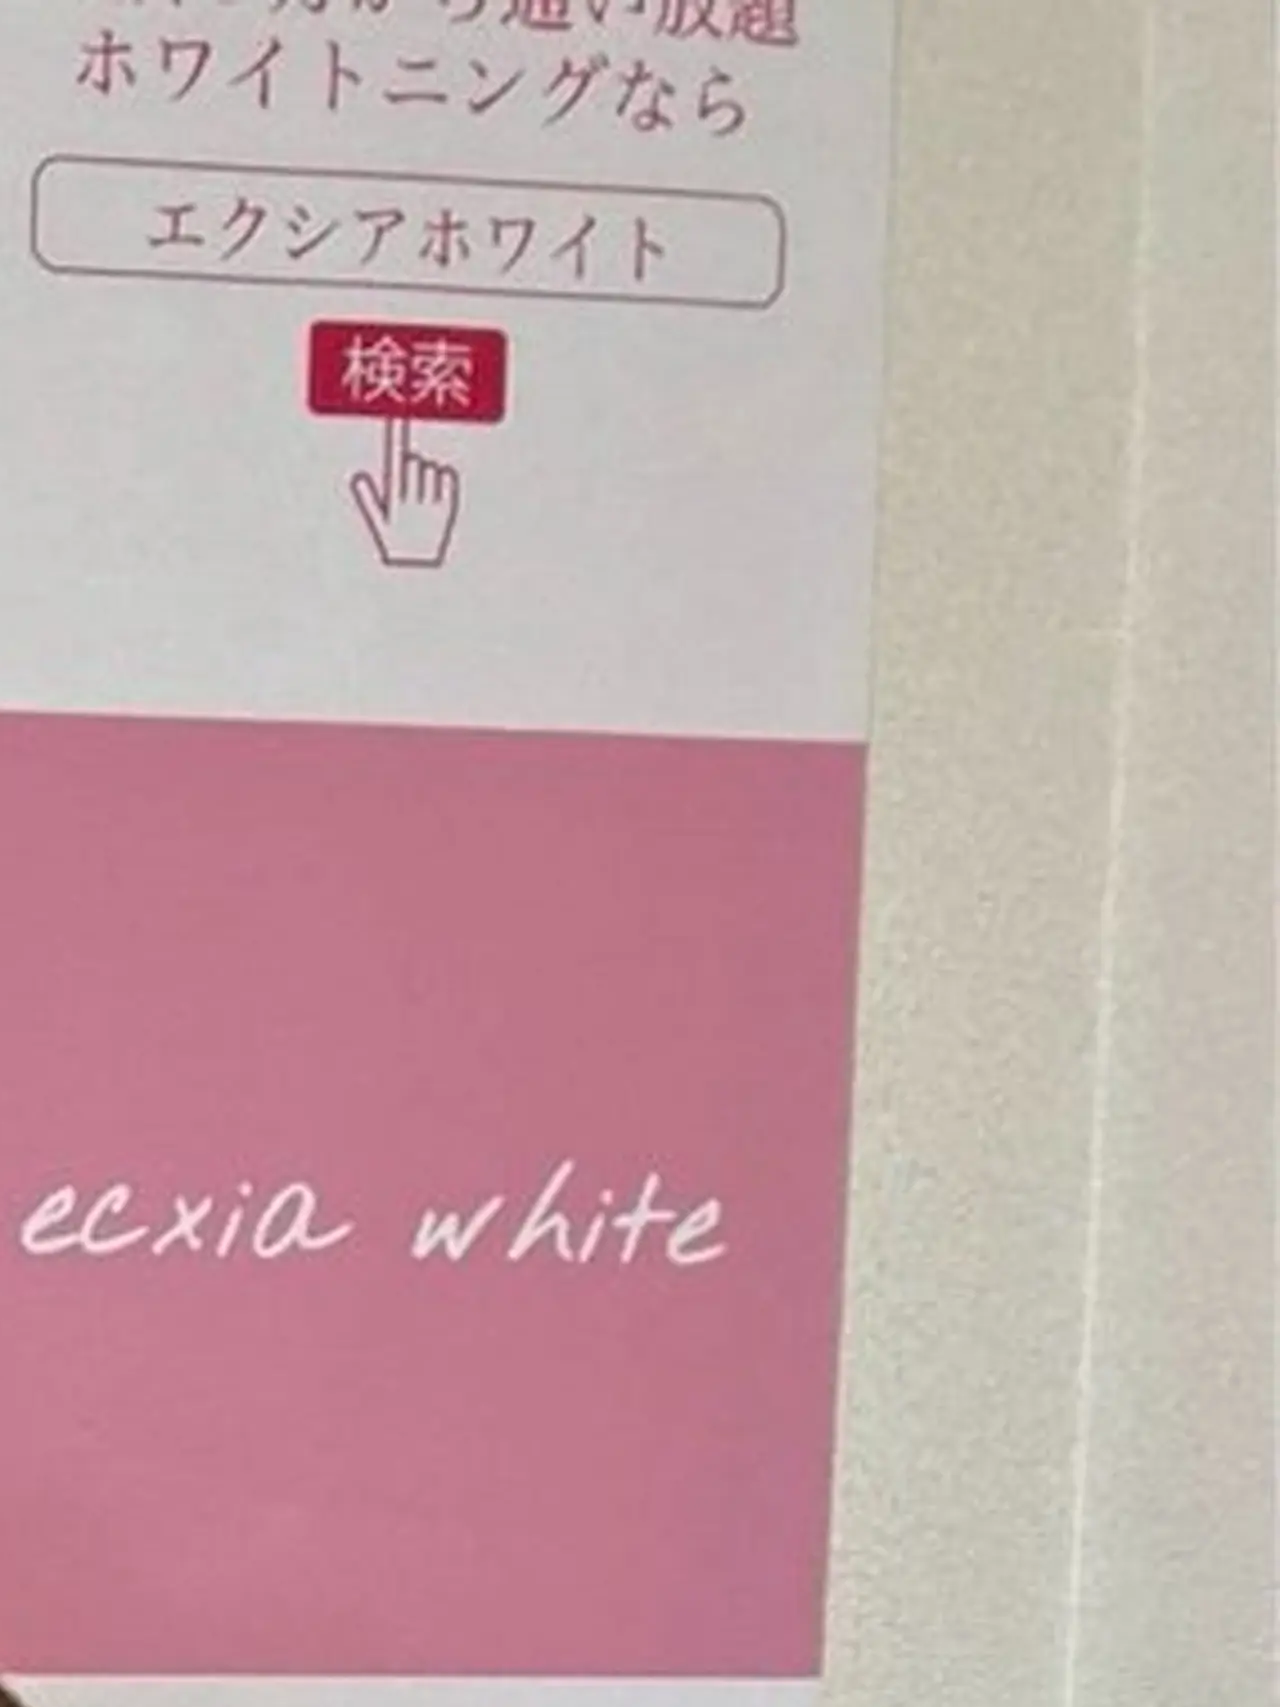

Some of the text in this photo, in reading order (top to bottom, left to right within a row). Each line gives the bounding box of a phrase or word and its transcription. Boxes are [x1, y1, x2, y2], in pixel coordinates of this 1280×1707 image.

[76, 28, 748, 136] ホワイトニングなら
[147, 195, 667, 284] エクシアホワイト
[341, 337, 474, 405] 検索
[20, 1160, 726, 1264] ecxia white
